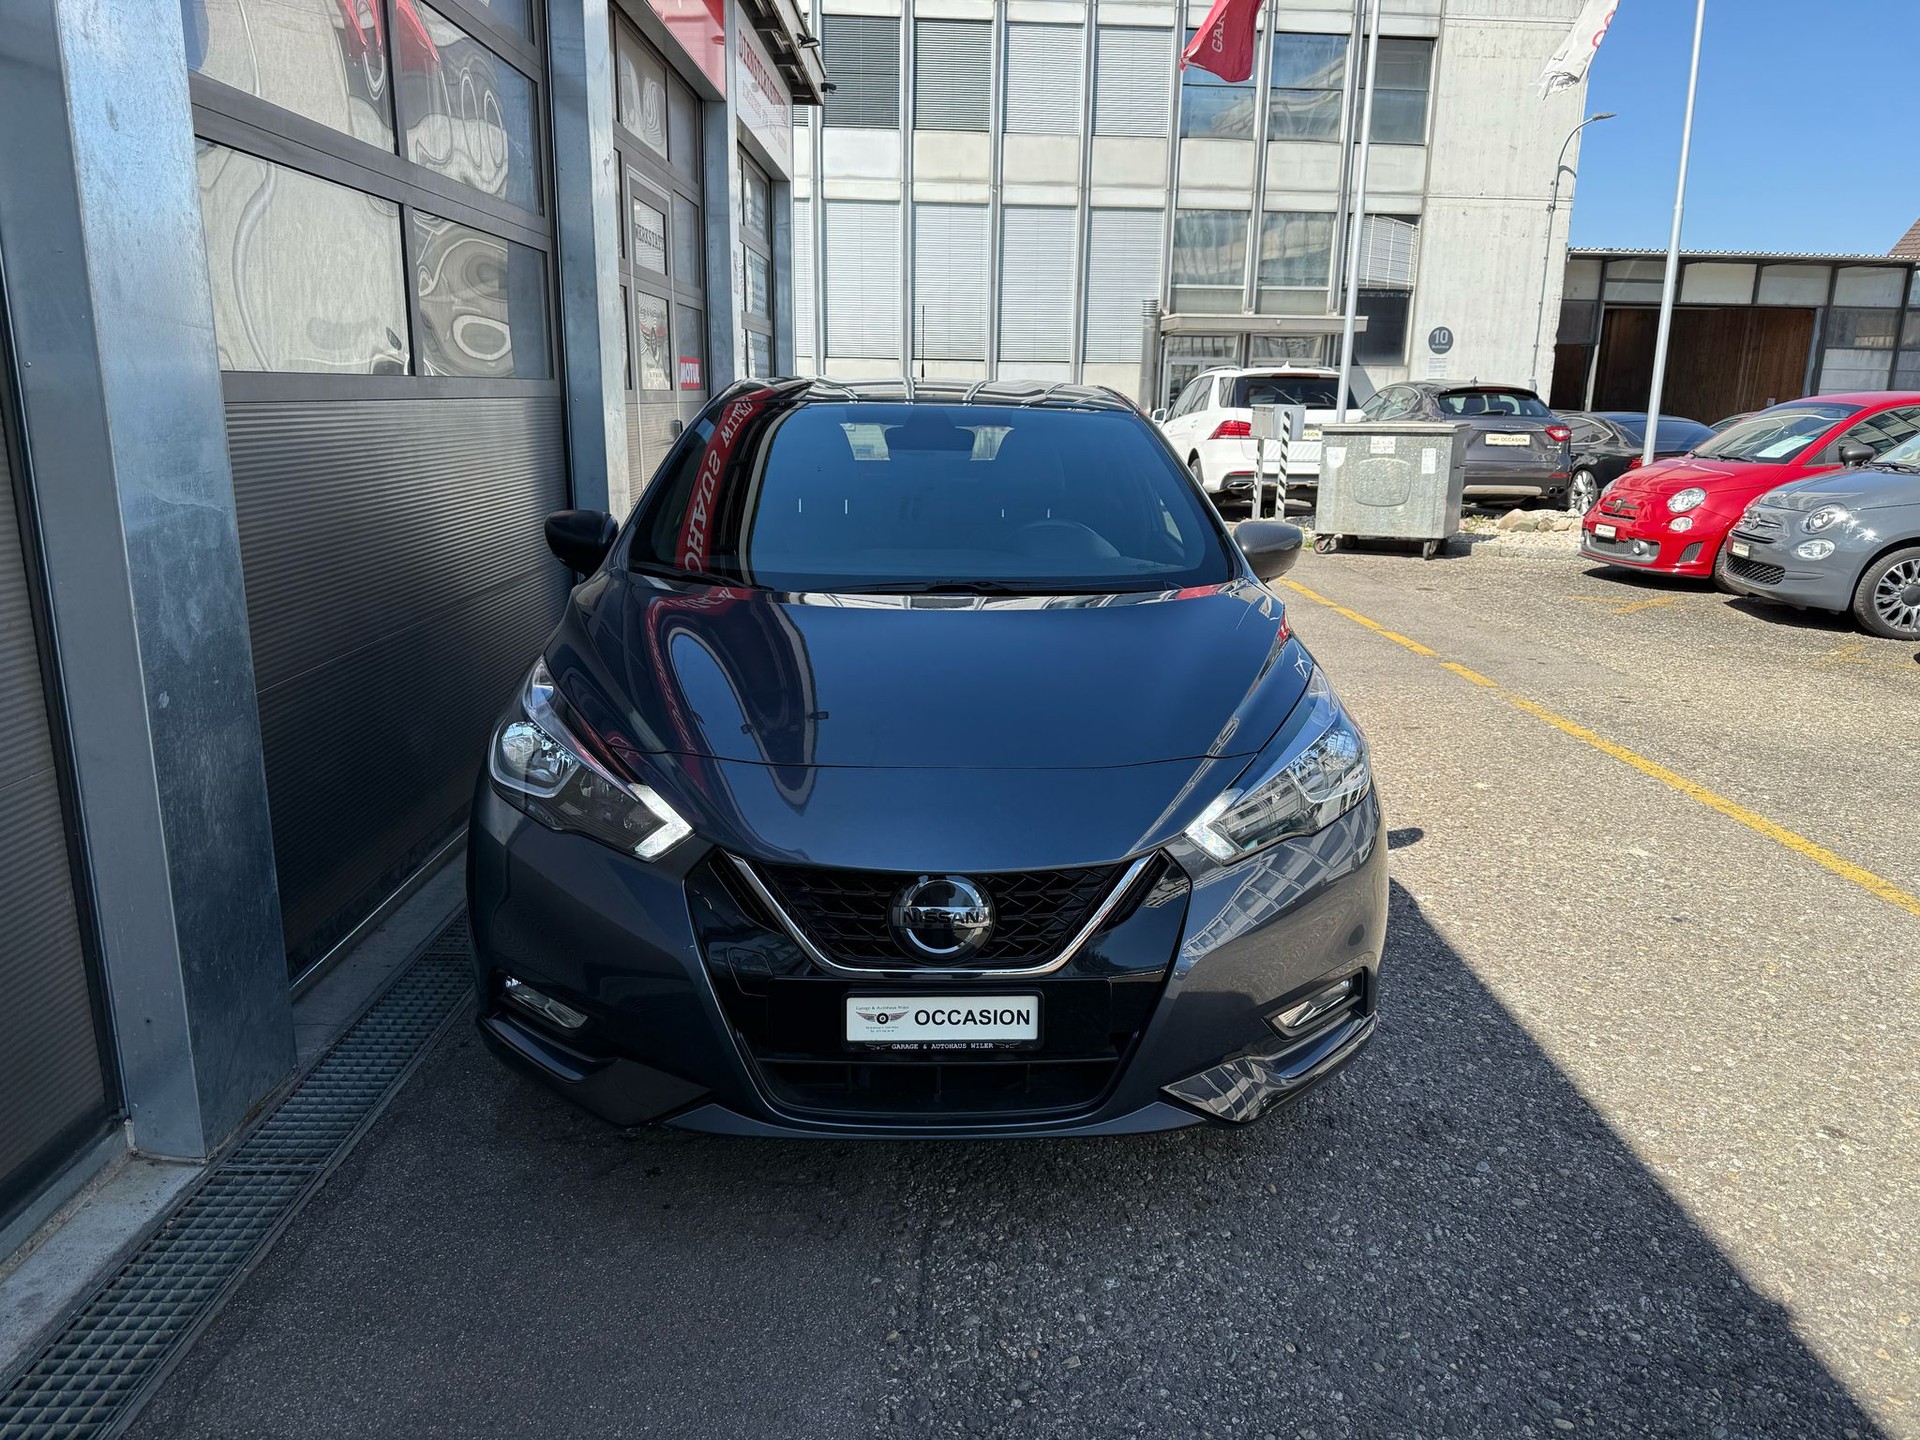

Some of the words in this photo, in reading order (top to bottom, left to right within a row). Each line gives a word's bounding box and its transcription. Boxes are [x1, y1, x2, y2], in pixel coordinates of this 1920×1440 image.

[1433, 329, 1449, 344] 10
[681, 362, 701, 384] MOTUL
[903, 911, 980, 924] NISSAN
[914, 1009, 1030, 1026] OCCASION
